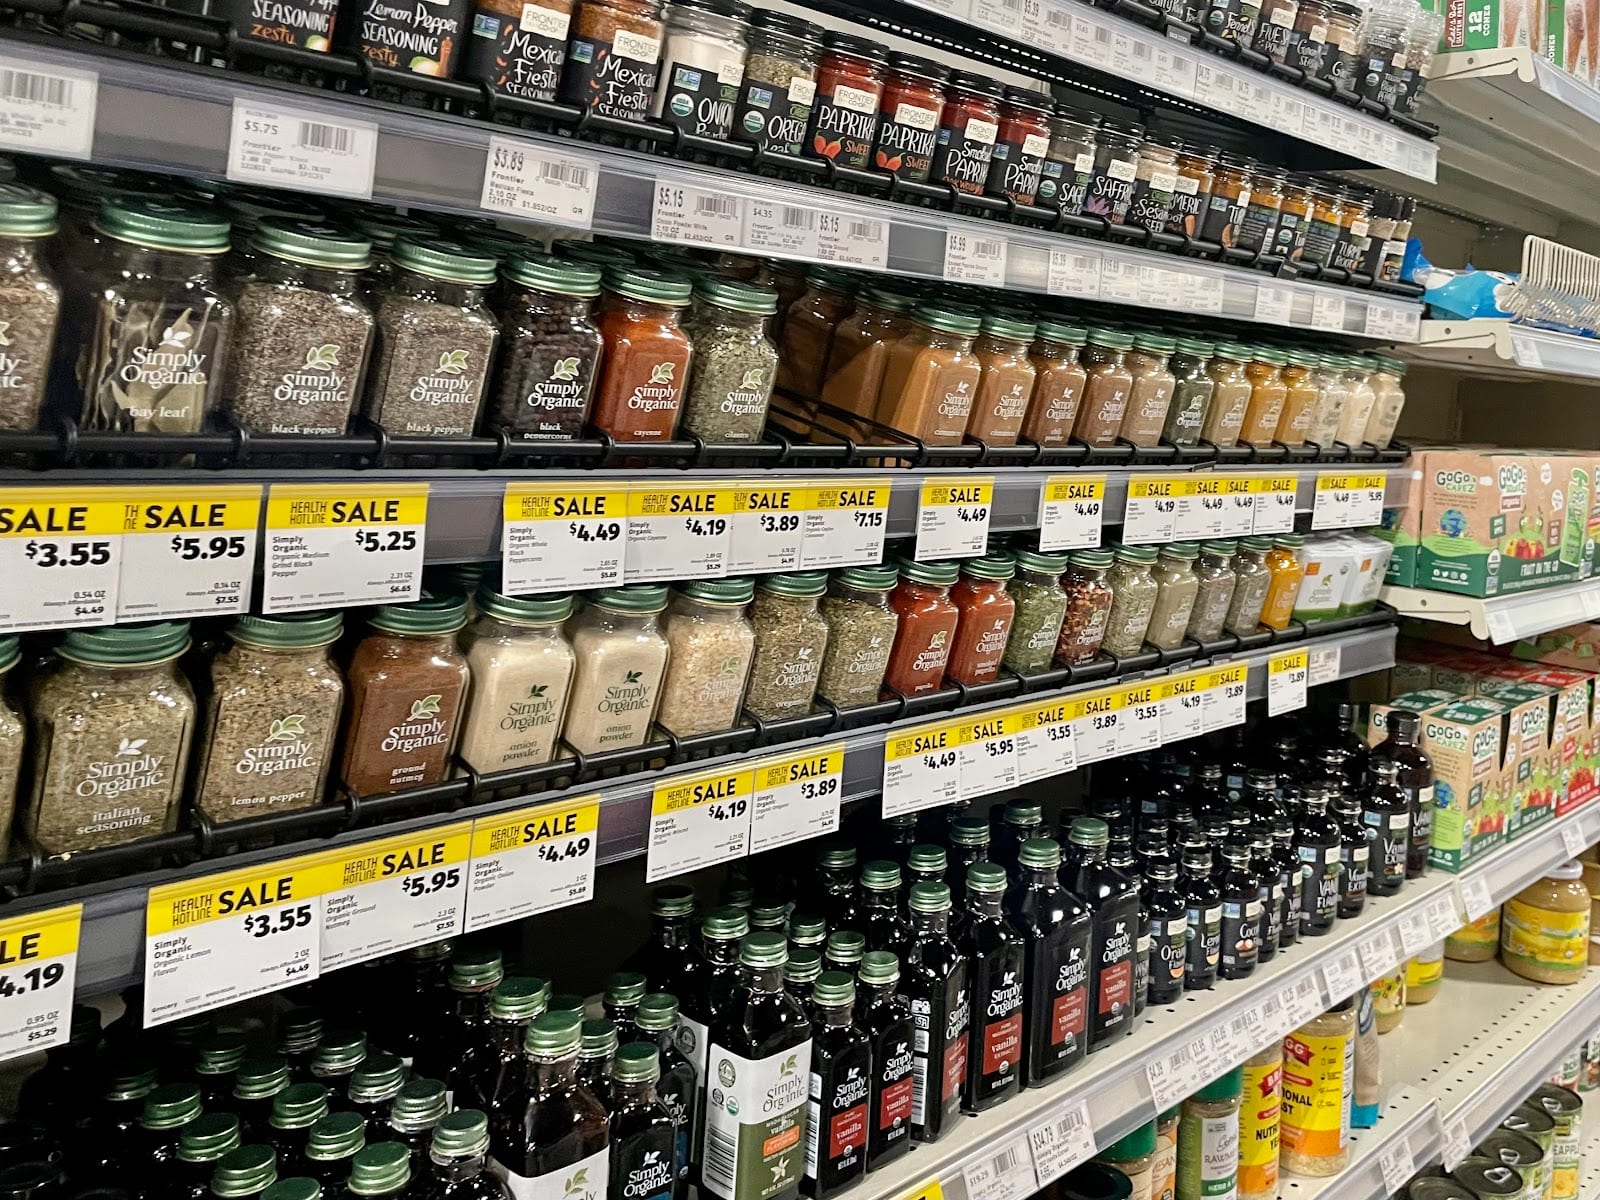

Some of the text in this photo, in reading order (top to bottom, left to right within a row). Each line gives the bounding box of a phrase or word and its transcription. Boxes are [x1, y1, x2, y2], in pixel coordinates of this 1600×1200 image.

[252, 1, 329, 32] SEASONING
[363, 0, 412, 23] Lemon
[414, 3, 458, 34] Pepper
[1468, 10, 1482, 33] 12
[362, 22, 439, 55] SEASONING
[245, 121, 278, 135] $5.75
[818, 106, 876, 140] PAPRIKA
[879, 123, 937, 157] PAPRIKA
[906, 156, 930, 170] SWEET
[492, 172, 524, 184] Frontier
[659, 187, 683, 207] $5.15
[658, 209, 685, 219] Frontier
[753, 208, 773, 219] $4.35
[820, 215, 839, 233] $5.15
[132, 347, 206, 373] Simply
[121, 364, 208, 389] Organic
[283, 371, 345, 393] Simply
[420, 374, 473, 392] Simply
[274, 385, 346, 405] Organic
[410, 387, 473, 405] Organic
[535, 380, 584, 398] Simply
[634, 384, 677, 400] Simply
[727, 389, 764, 405] Simply
[528, 391, 584, 410] Organic
[628, 396, 678, 412] Organic
[130, 406, 189, 419] bay leaf
[271, 424, 337, 435] black pepper
[407, 422, 464, 434] black pepper
[540, 423, 560, 431] black
[1069, 485, 1095, 499] SALE
[1147, 483, 1170, 496] SALE
[1197, 482, 1218, 494] SALE
[1229, 481, 1249, 492] SALE
[1272, 480, 1290, 491] SALE
[522, 497, 550, 507] HEALTH
[643, 495, 667, 504] HEALTH
[670, 495, 716, 512] SALE
[749, 493, 790, 509] SALE
[839, 491, 875, 506] SALE
[949, 488, 980, 503] SALE
[1202, 497, 1223, 510] $4.49
[1234, 497, 1252, 508] $4.49
[1276, 495, 1293, 505] $4.49
[291, 501, 327, 513] HEALTH
[332, 501, 399, 523] SALE
[522, 508, 549, 517] HOTLINE
[554, 497, 606, 516] SALE
[642, 505, 665, 513] HOTLINE
[1075, 503, 1099, 516] $4.49
[1155, 500, 1174, 513] $4.19
[145, 504, 226, 529] SALE
[290, 513, 325, 525] HOTLINE
[760, 514, 798, 532] $3.89
[854, 510, 882, 527] $7.15
[957, 508, 986, 522] $4.49
[569, 521, 620, 541] $4.49
[685, 517, 726, 535] $4.19
[171, 535, 245, 560] $5.95
[273, 536, 303, 544] Simply
[273, 544, 308, 552] Organic
[355, 529, 416, 552] $5.25
[25, 541, 110, 567] $3.55
[95, 590, 106, 598] OZ
[215, 595, 239, 604] $7.55
[919, 649, 947, 662] Simply
[605, 684, 649, 701] Simply
[1225, 685, 1244, 699] $3.89
[509, 698, 558, 719] Simply
[598, 698, 648, 716] Organic
[1181, 696, 1200, 708] $4.19
[1037, 708, 1064, 725] SALE
[1135, 706, 1157, 720] $3.55
[389, 718, 447, 740] Simply
[500, 711, 555, 733] Organic
[606, 725, 632, 733] onion
[974, 721, 1003, 739] SALE
[1093, 715, 1117, 730] $3.89
[599, 731, 633, 743] powder
[1047, 725, 1071, 742] $3.55
[1427, 724, 1461, 738] GoGo
[244, 740, 312, 761] Simply
[381, 733, 448, 753] Organic
[510, 740, 538, 750] onion
[914, 733, 947, 753] SALE
[986, 740, 1014, 756] $5.95
[503, 747, 539, 762] powder
[924, 752, 956, 769] $4.49
[86, 754, 164, 780] Simply
[236, 755, 316, 776] Organic
[392, 762, 425, 776] ground
[768, 766, 788, 778] HEALTH
[790, 758, 828, 781] SALE
[76, 770, 163, 798] Organic
[389, 772, 424, 785] nutmeg
[668, 788, 691, 800] HEALTH
[693, 778, 736, 804] SALE
[801, 778, 837, 799] $3.89
[231, 791, 306, 806] lemon pepper
[667, 798, 689, 809] HOTLINE
[93, 806, 140, 822] italian
[708, 800, 746, 820] $4.19
[76, 813, 150, 835] seasoning
[523, 814, 577, 843] SALE
[492, 826, 520, 840] HEALTH
[490, 837, 518, 852] HOTLINE
[538, 838, 590, 862] $4.49
[344, 858, 378, 873] HEALTH
[382, 843, 445, 876] SALE
[476, 860, 500, 870] Simply
[343, 869, 376, 885] HOTLINE
[475, 866, 502, 877] Organic
[402, 867, 460, 898] $5.95
[474, 882, 495, 891] Powder
[173, 894, 213, 913] HEALTH
[219, 877, 293, 914] SALE
[327, 902, 358, 914] Organic
[357, 904, 376, 914] Ground
[172, 907, 212, 926] HOTLINE
[244, 905, 311, 938] $3.55
[326, 920, 350, 930] Nutmeg
[436, 920, 454, 931] $7.55
[154, 936, 188, 950] Simply
[154, 944, 192, 959] Organic
[186, 949, 211, 960] Lemon
[294, 949, 310, 959] 2 OZ
[153, 966, 178, 977] Flavor
[286, 964, 310, 976] $4.49
[992, 983, 1022, 1003] Simply
[152, 1001, 178, 1012] Grocery
[988, 996, 1023, 1016] Organic
[47, 1011, 59, 1021] OZ
[28, 1028, 57, 1040] $5.29
[837, 1076, 866, 1097] Simply
[833, 1091, 868, 1109] Organic
[886, 1095, 909, 1111] vanilla
[836, 1122, 862, 1139] vanilla
[629, 1161, 670, 1184] Simply
[624, 1174, 672, 1197] Organic
